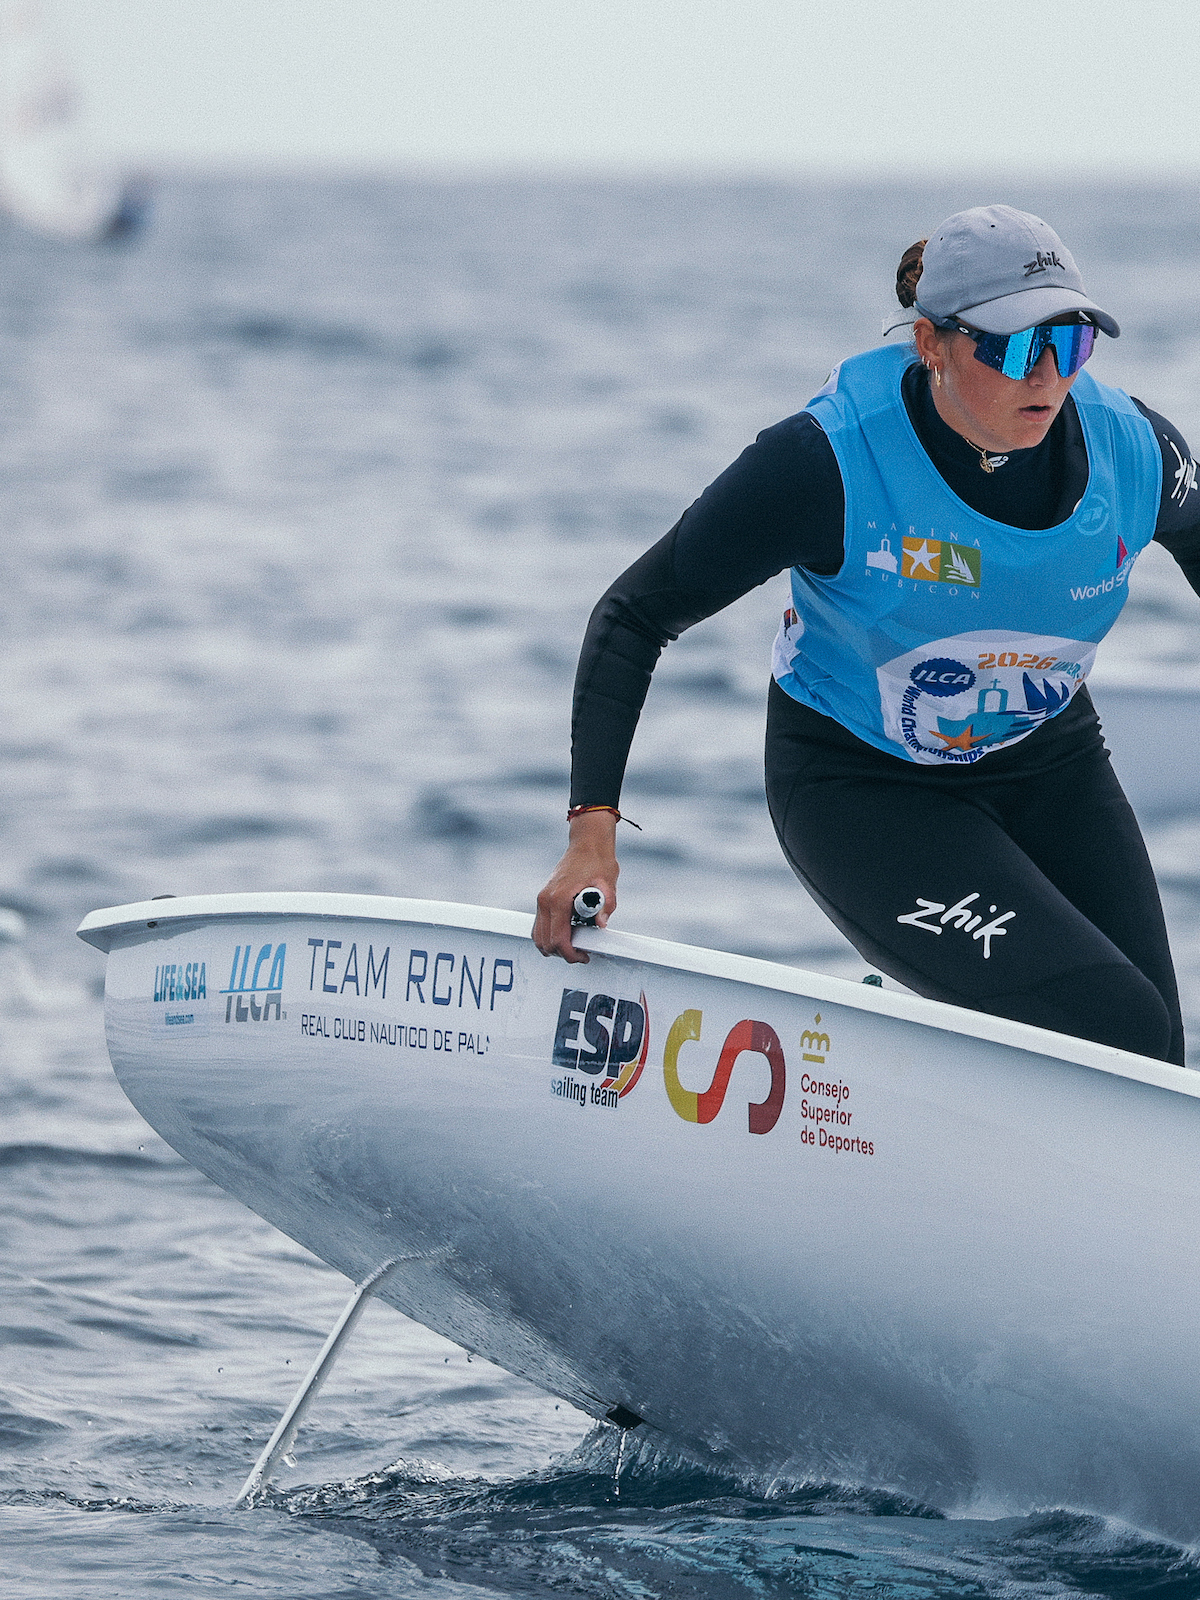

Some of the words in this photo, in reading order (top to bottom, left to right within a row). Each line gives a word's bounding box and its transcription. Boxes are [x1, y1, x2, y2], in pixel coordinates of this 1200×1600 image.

[1023, 251, 1066, 277] zhik
[867, 520, 981, 548] MARINA
[1069, 576, 1115, 601] World
[914, 667, 971, 686] ILCA
[978, 652, 1058, 670] 2026
[901, 685, 922, 717] World
[896, 892, 1017, 960] zhik
[153, 961, 207, 1003] LIFE&SEA
[307, 937, 391, 1000] TEAM
[405, 948, 514, 1012] RCNP
[301, 1013, 330, 1038] REAL
[334, 1017, 366, 1042] CLUB
[370, 1021, 428, 1050] NAUTICO
[433, 1029, 453, 1053] DE
[458, 1032, 491, 1056] PAL
[551, 987, 645, 1079] ESP
[550, 1076, 587, 1107] sailing
[590, 1082, 619, 1109] team
[800, 1073, 850, 1104] Consejo
[800, 1098, 853, 1126] Superior
[800, 1124, 816, 1146] de
[818, 1127, 874, 1156] Deportes
